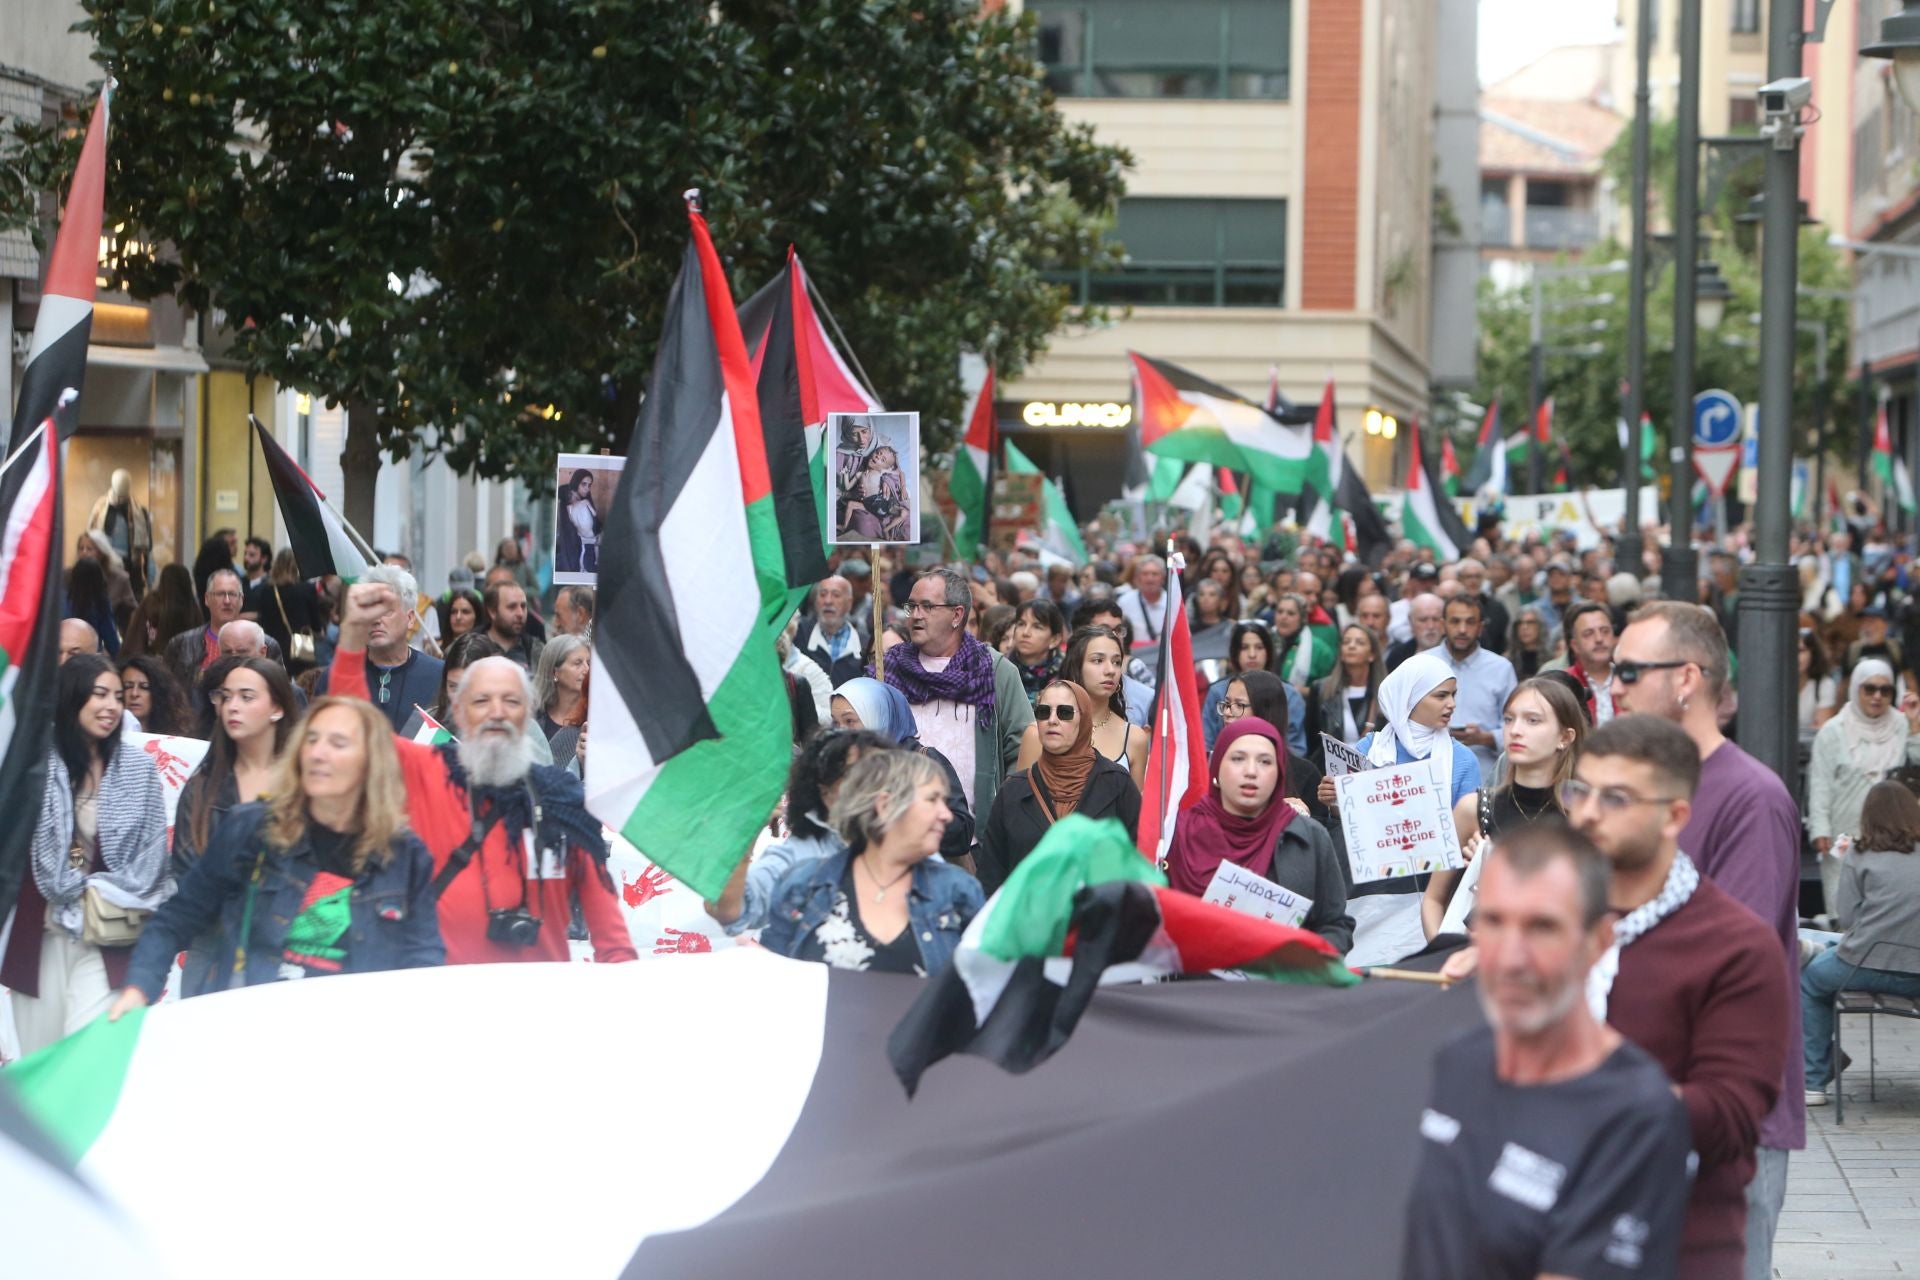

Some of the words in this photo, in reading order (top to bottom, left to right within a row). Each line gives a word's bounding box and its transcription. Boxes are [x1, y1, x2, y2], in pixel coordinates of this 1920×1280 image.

[1375, 775, 1412, 791] STOP
[1366, 785, 1426, 804] GENOCIDE
[1385, 819, 1422, 836] STOP
[1376, 830, 1436, 849] GENOCIDE
[1218, 872, 1295, 908] LIBRE
